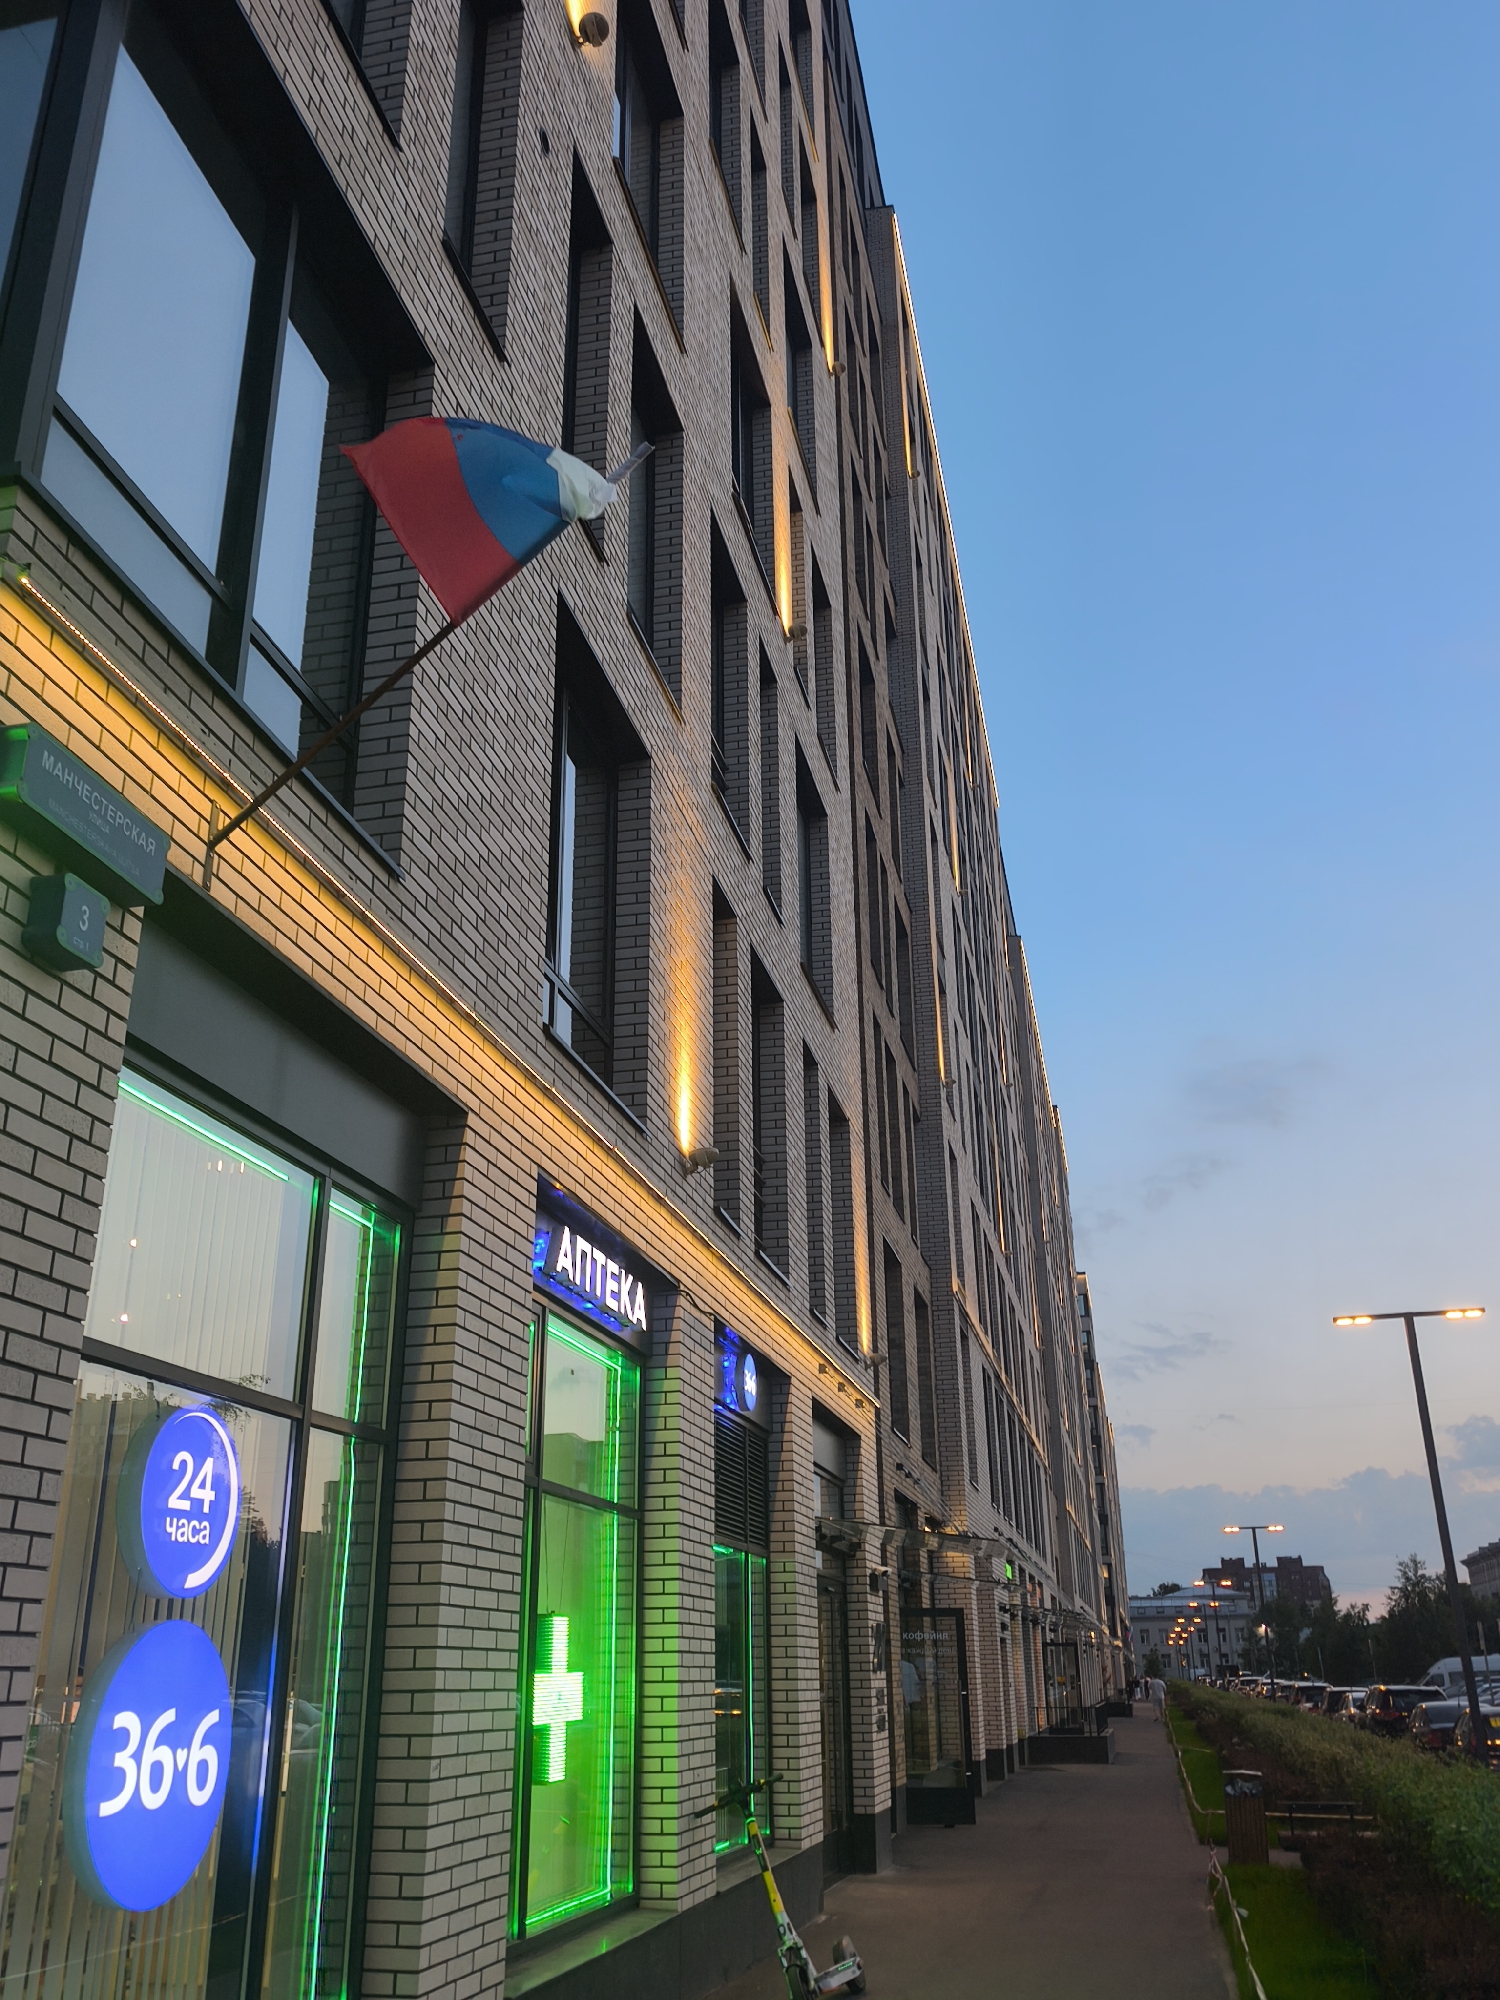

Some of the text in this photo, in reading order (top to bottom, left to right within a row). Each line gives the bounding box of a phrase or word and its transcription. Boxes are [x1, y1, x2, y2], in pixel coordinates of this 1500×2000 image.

[42, 750, 156, 856] МАНЧЕСТЕРСКАЯ
[79, 905, 90, 932] 3
[556, 1225, 647, 1332] АПТЕКА
[167, 1450, 216, 1515] 24
[165, 1516, 210, 1546] часа
[902, 1629, 949, 1642] кофейня
